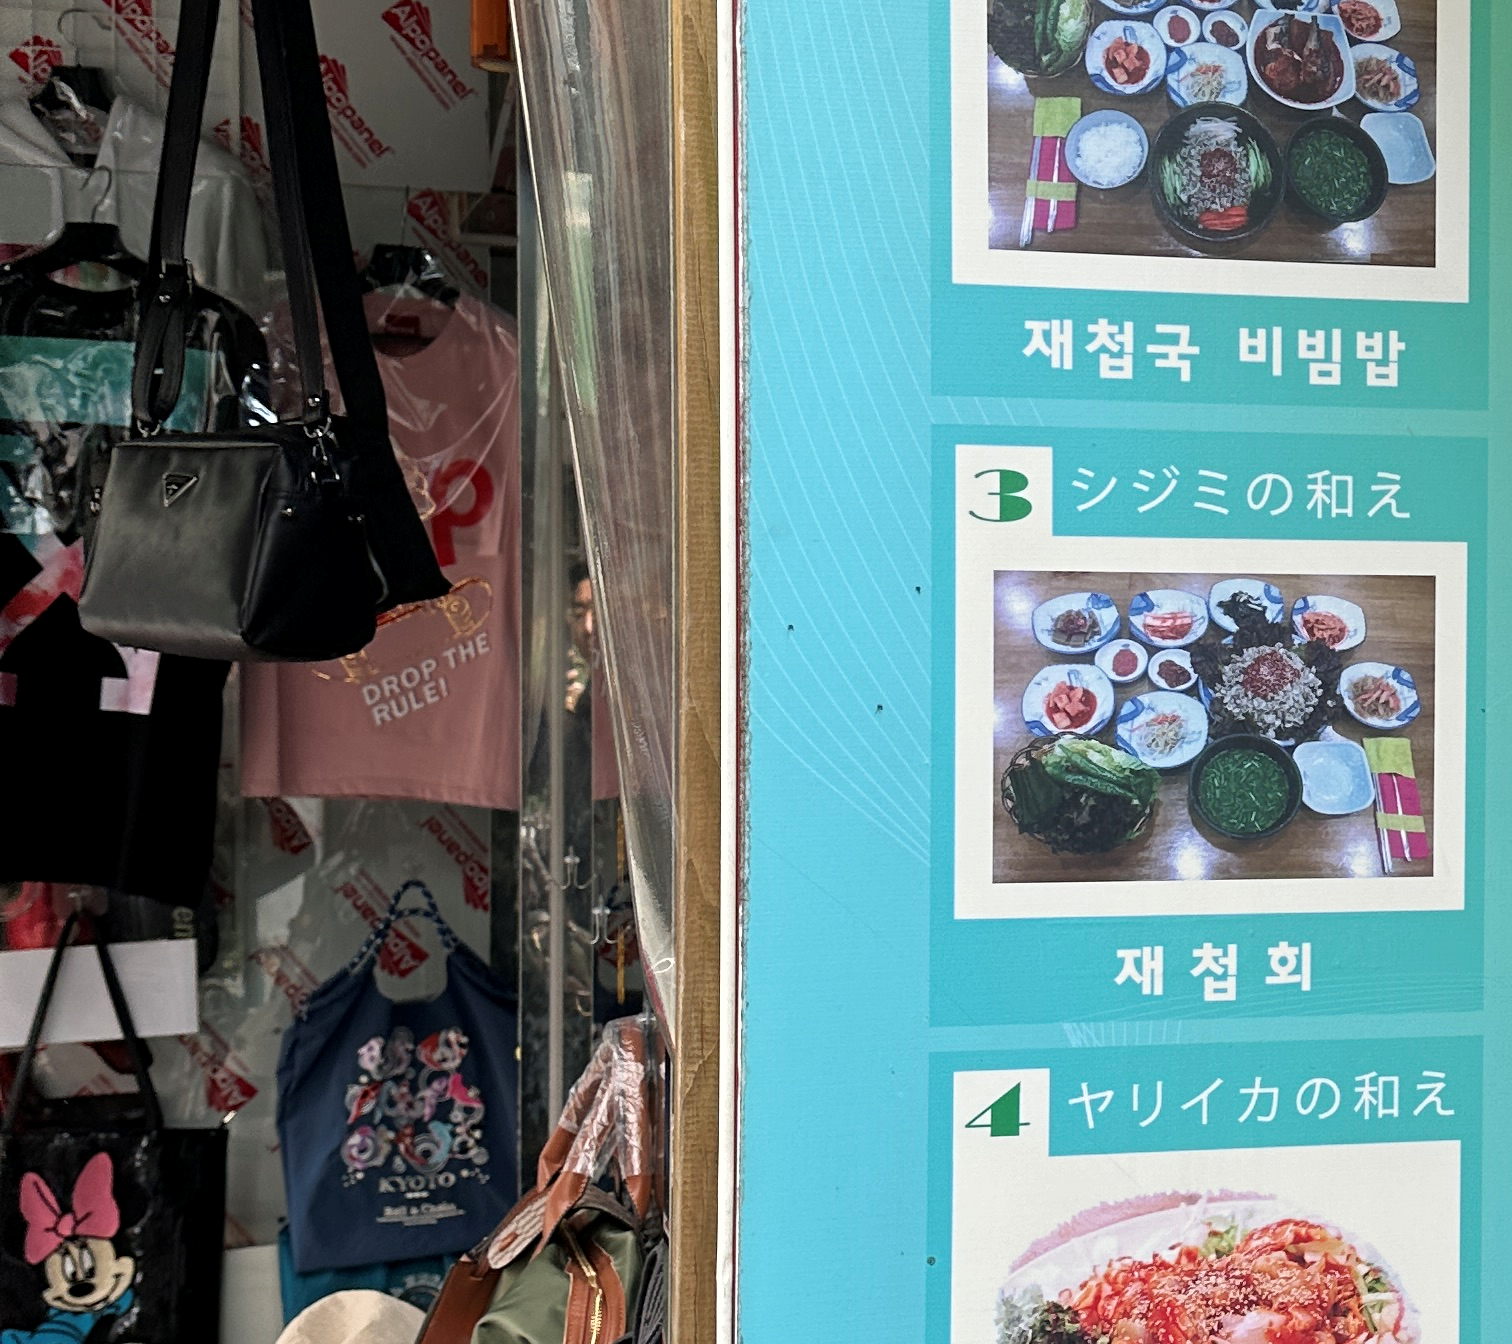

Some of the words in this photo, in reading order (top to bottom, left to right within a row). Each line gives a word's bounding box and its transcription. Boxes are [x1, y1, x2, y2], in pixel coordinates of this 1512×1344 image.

[1022, 318, 1200, 382] 재첩국
[1238, 327, 1406, 387] 비빔밥
[968, 469, 1033, 522] 3
[1071, 464, 1412, 520] シジミの和え
[362, 658, 438, 707] DROP
[443, 632, 491, 670] THE
[371, 677, 448, 727] RULE!
[1114, 941, 1314, 1002] 재첩회
[964, 1081, 1031, 1137] 4
[1068, 1070, 1456, 1130] ヤリイカの和え
